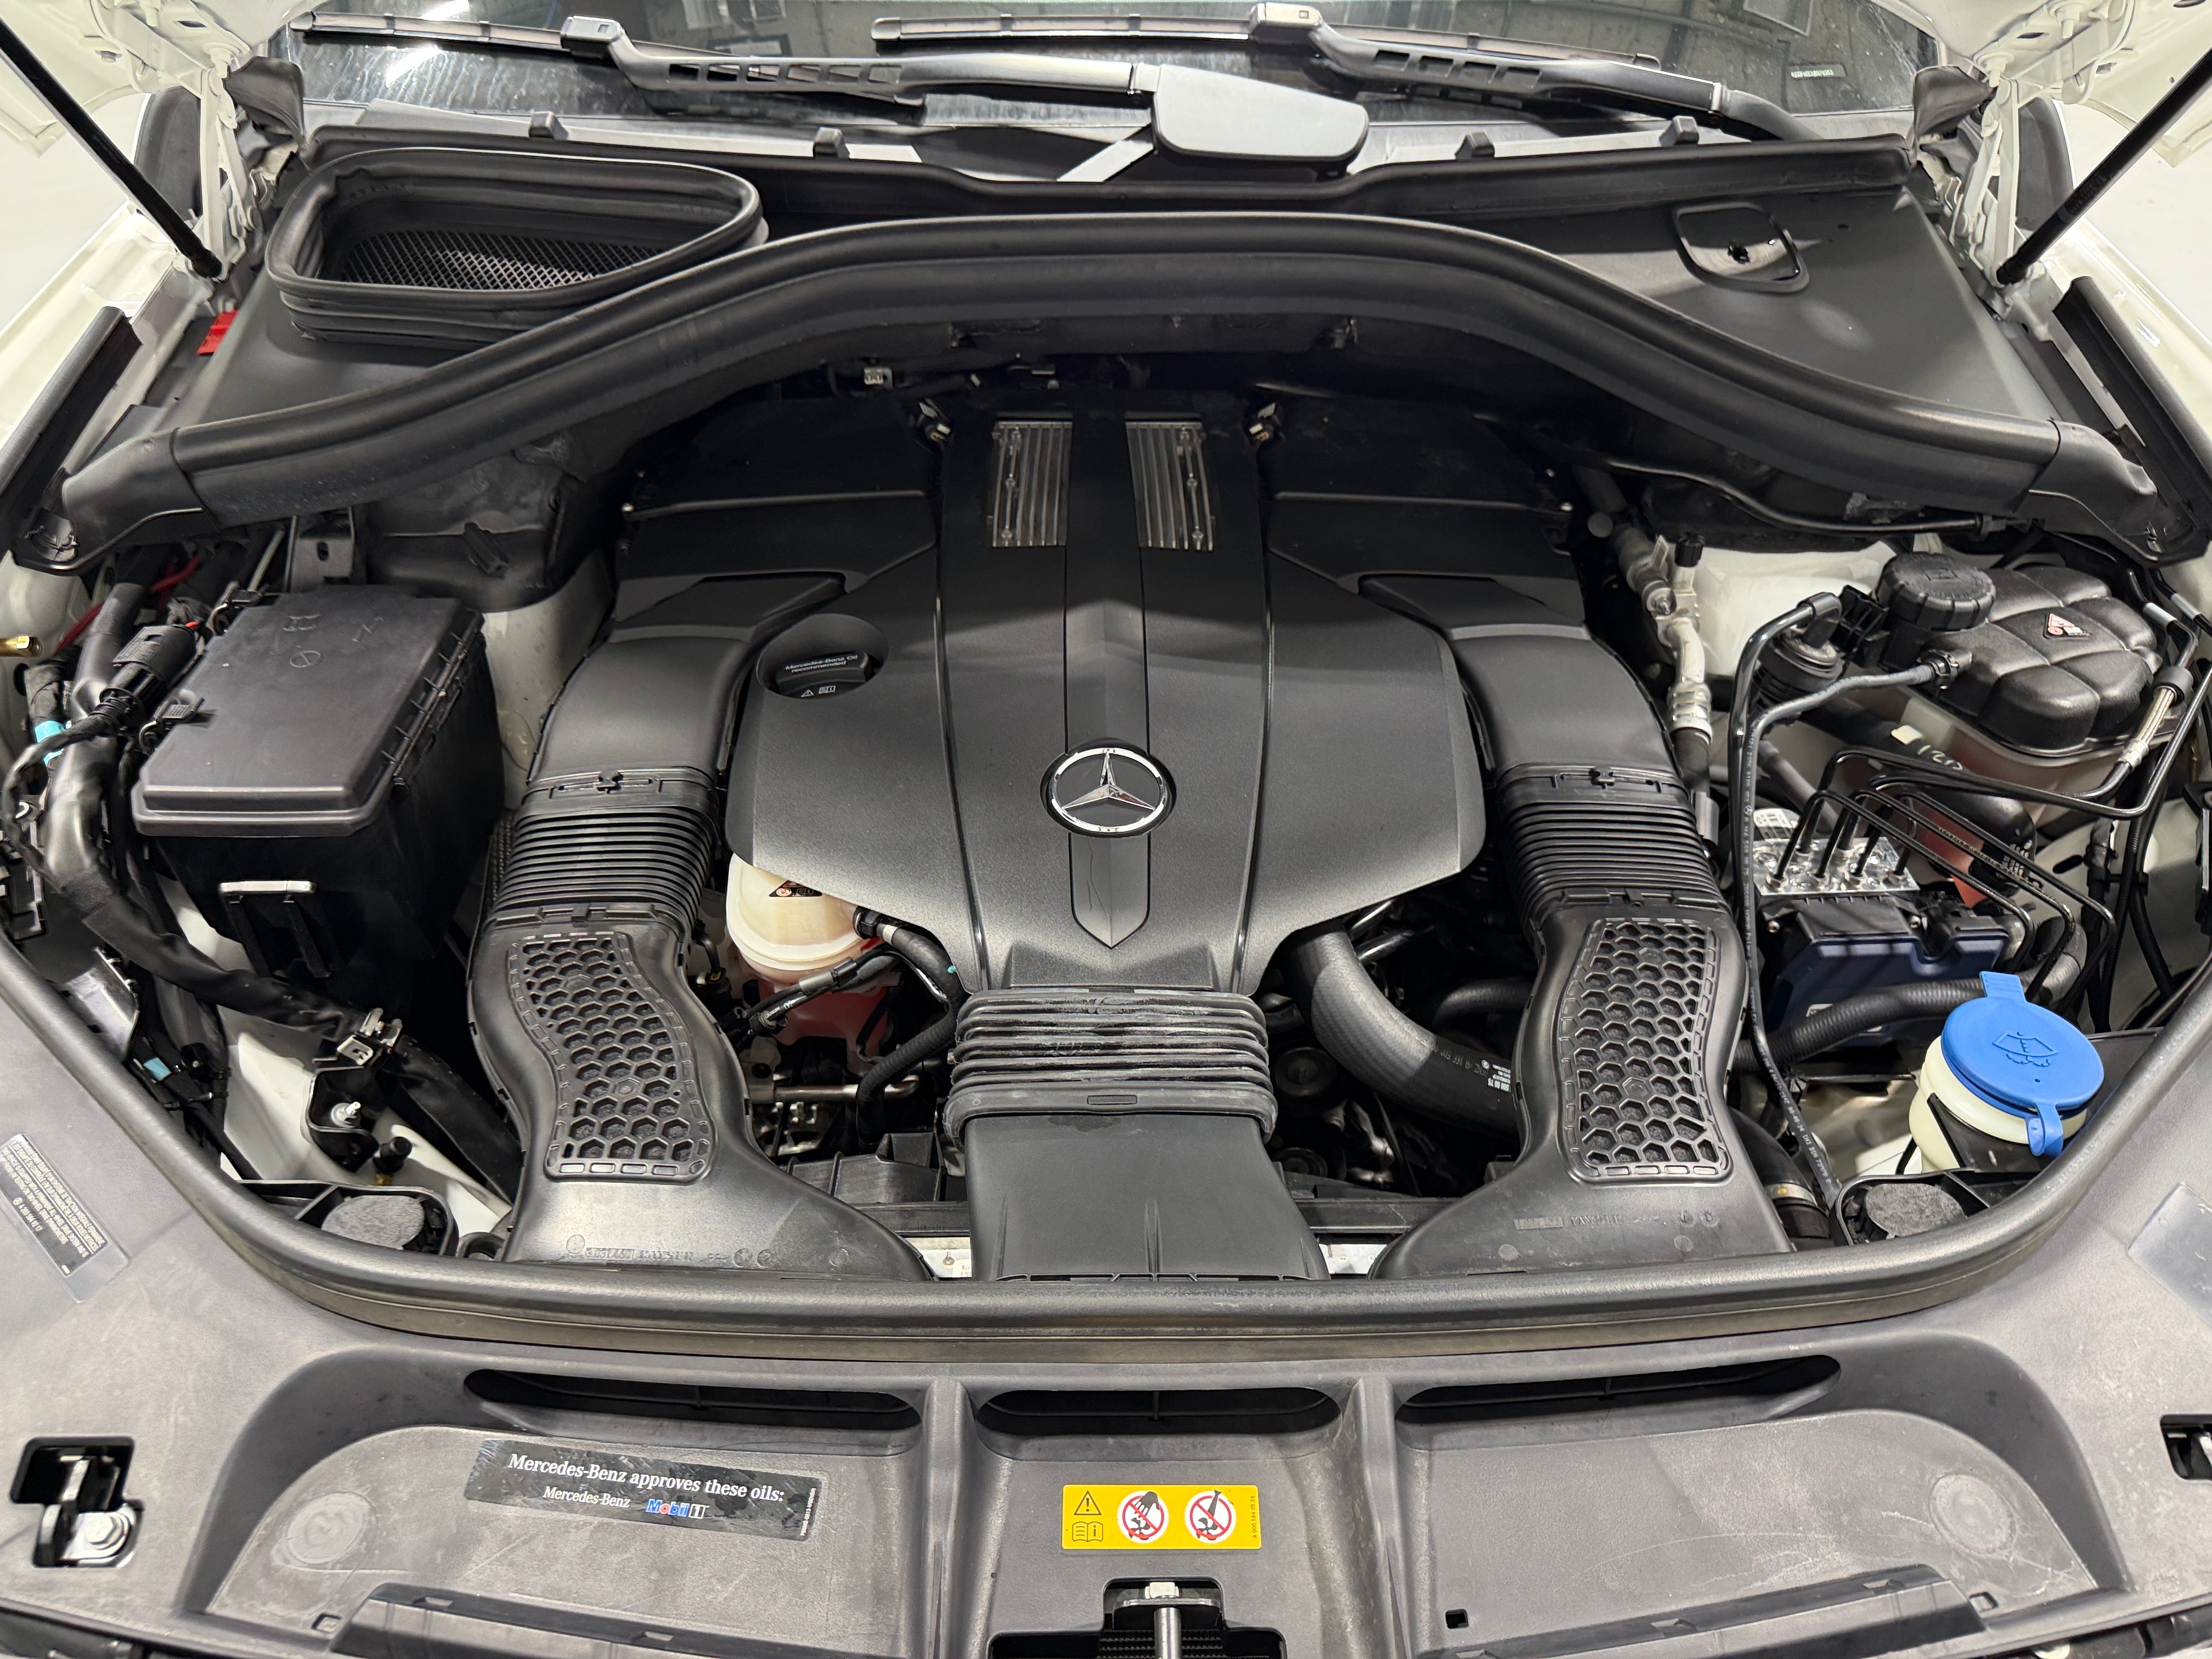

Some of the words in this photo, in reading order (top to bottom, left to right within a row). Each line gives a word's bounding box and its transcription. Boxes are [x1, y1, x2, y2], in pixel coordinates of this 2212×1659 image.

[785, 657, 845, 670] Mercedes-Benz
[791, 660, 847, 673] recommended
[507, 1453, 628, 1484] Mercedes-Benz
[629, 1472, 700, 1493] approves
[704, 1480, 747, 1499] these
[751, 1486, 785, 1502] oils:
[543, 1486, 631, 1509] Mercedes-Benz
[646, 1498, 688, 1517] Mobil
